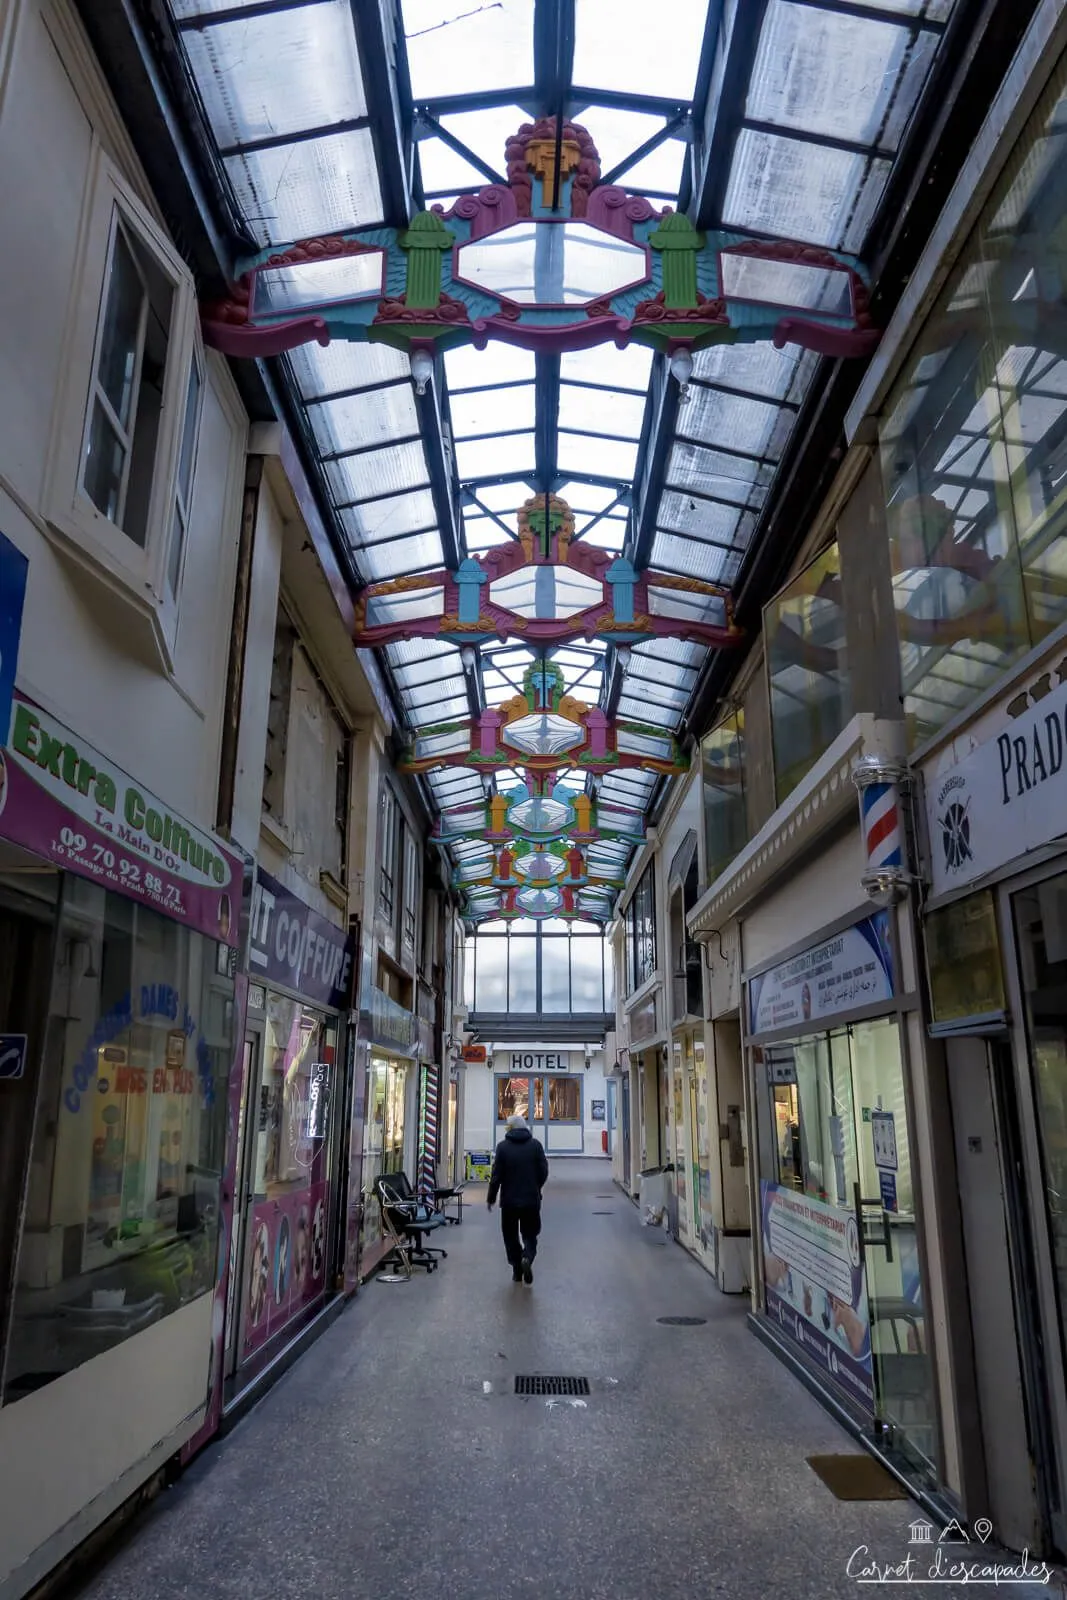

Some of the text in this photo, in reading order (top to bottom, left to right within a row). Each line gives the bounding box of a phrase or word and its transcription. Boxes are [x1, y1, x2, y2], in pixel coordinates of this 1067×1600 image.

[13, 703, 117, 814] Extra
[998, 703, 1067, 805] PRAD
[51, 840, 65, 854] 16
[67, 847, 105, 875] Passage
[106, 869, 119, 882] du
[60, 827, 182, 904] 09 70 92 88 71
[95, 809, 181, 873] La Main D'Or
[275, 909, 352, 993] COIFFURE
[511, 1054, 567, 1069] HOTEL
